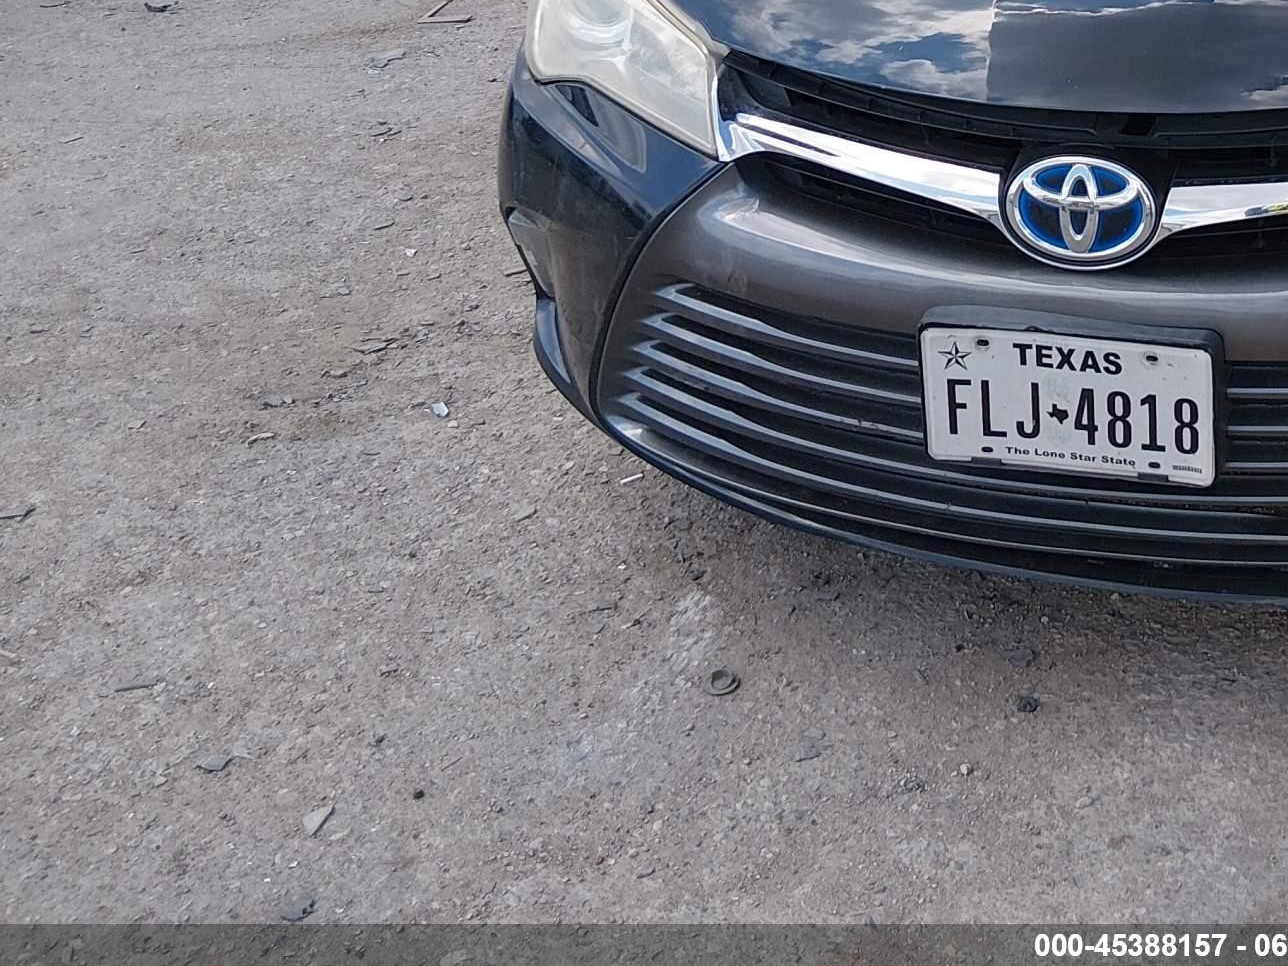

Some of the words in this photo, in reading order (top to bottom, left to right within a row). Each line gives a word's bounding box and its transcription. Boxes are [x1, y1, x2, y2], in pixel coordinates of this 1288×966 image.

[1012, 342, 1123, 375] TEXAS
[1005, 446, 1031, 456] The
[1034, 447, 1066, 460] Lone
[1069, 451, 1098, 464] Star
[1101, 454, 1137, 467] State
